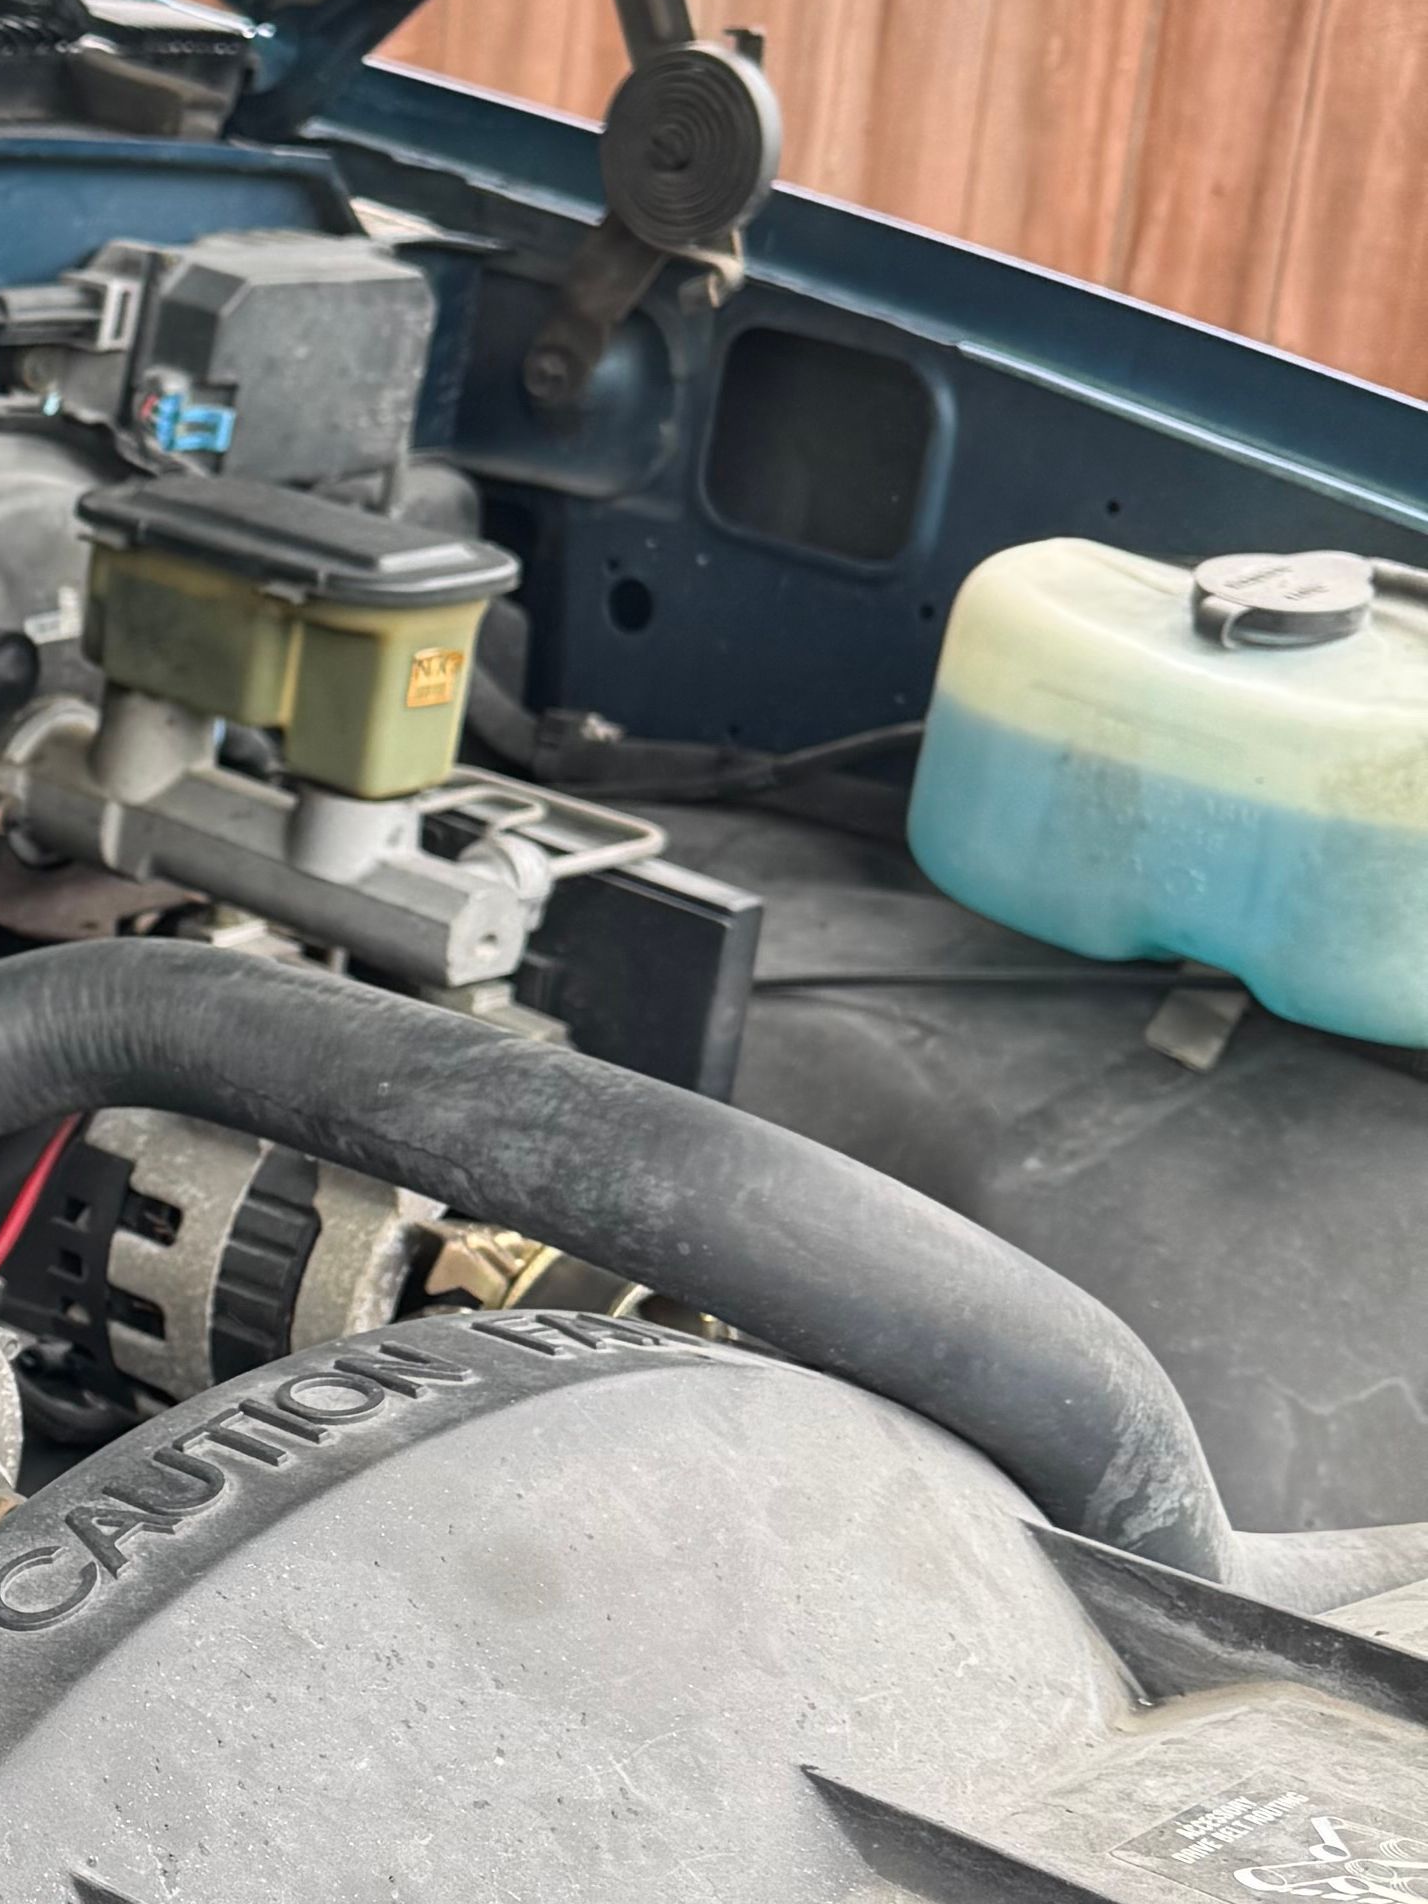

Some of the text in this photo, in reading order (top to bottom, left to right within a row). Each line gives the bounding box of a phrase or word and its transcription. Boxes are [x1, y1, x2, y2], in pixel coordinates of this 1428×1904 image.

[1170, 1791, 1311, 1865] DRIVE BELT ROUTING
[1175, 1796, 1258, 1841] ACCESSORY
